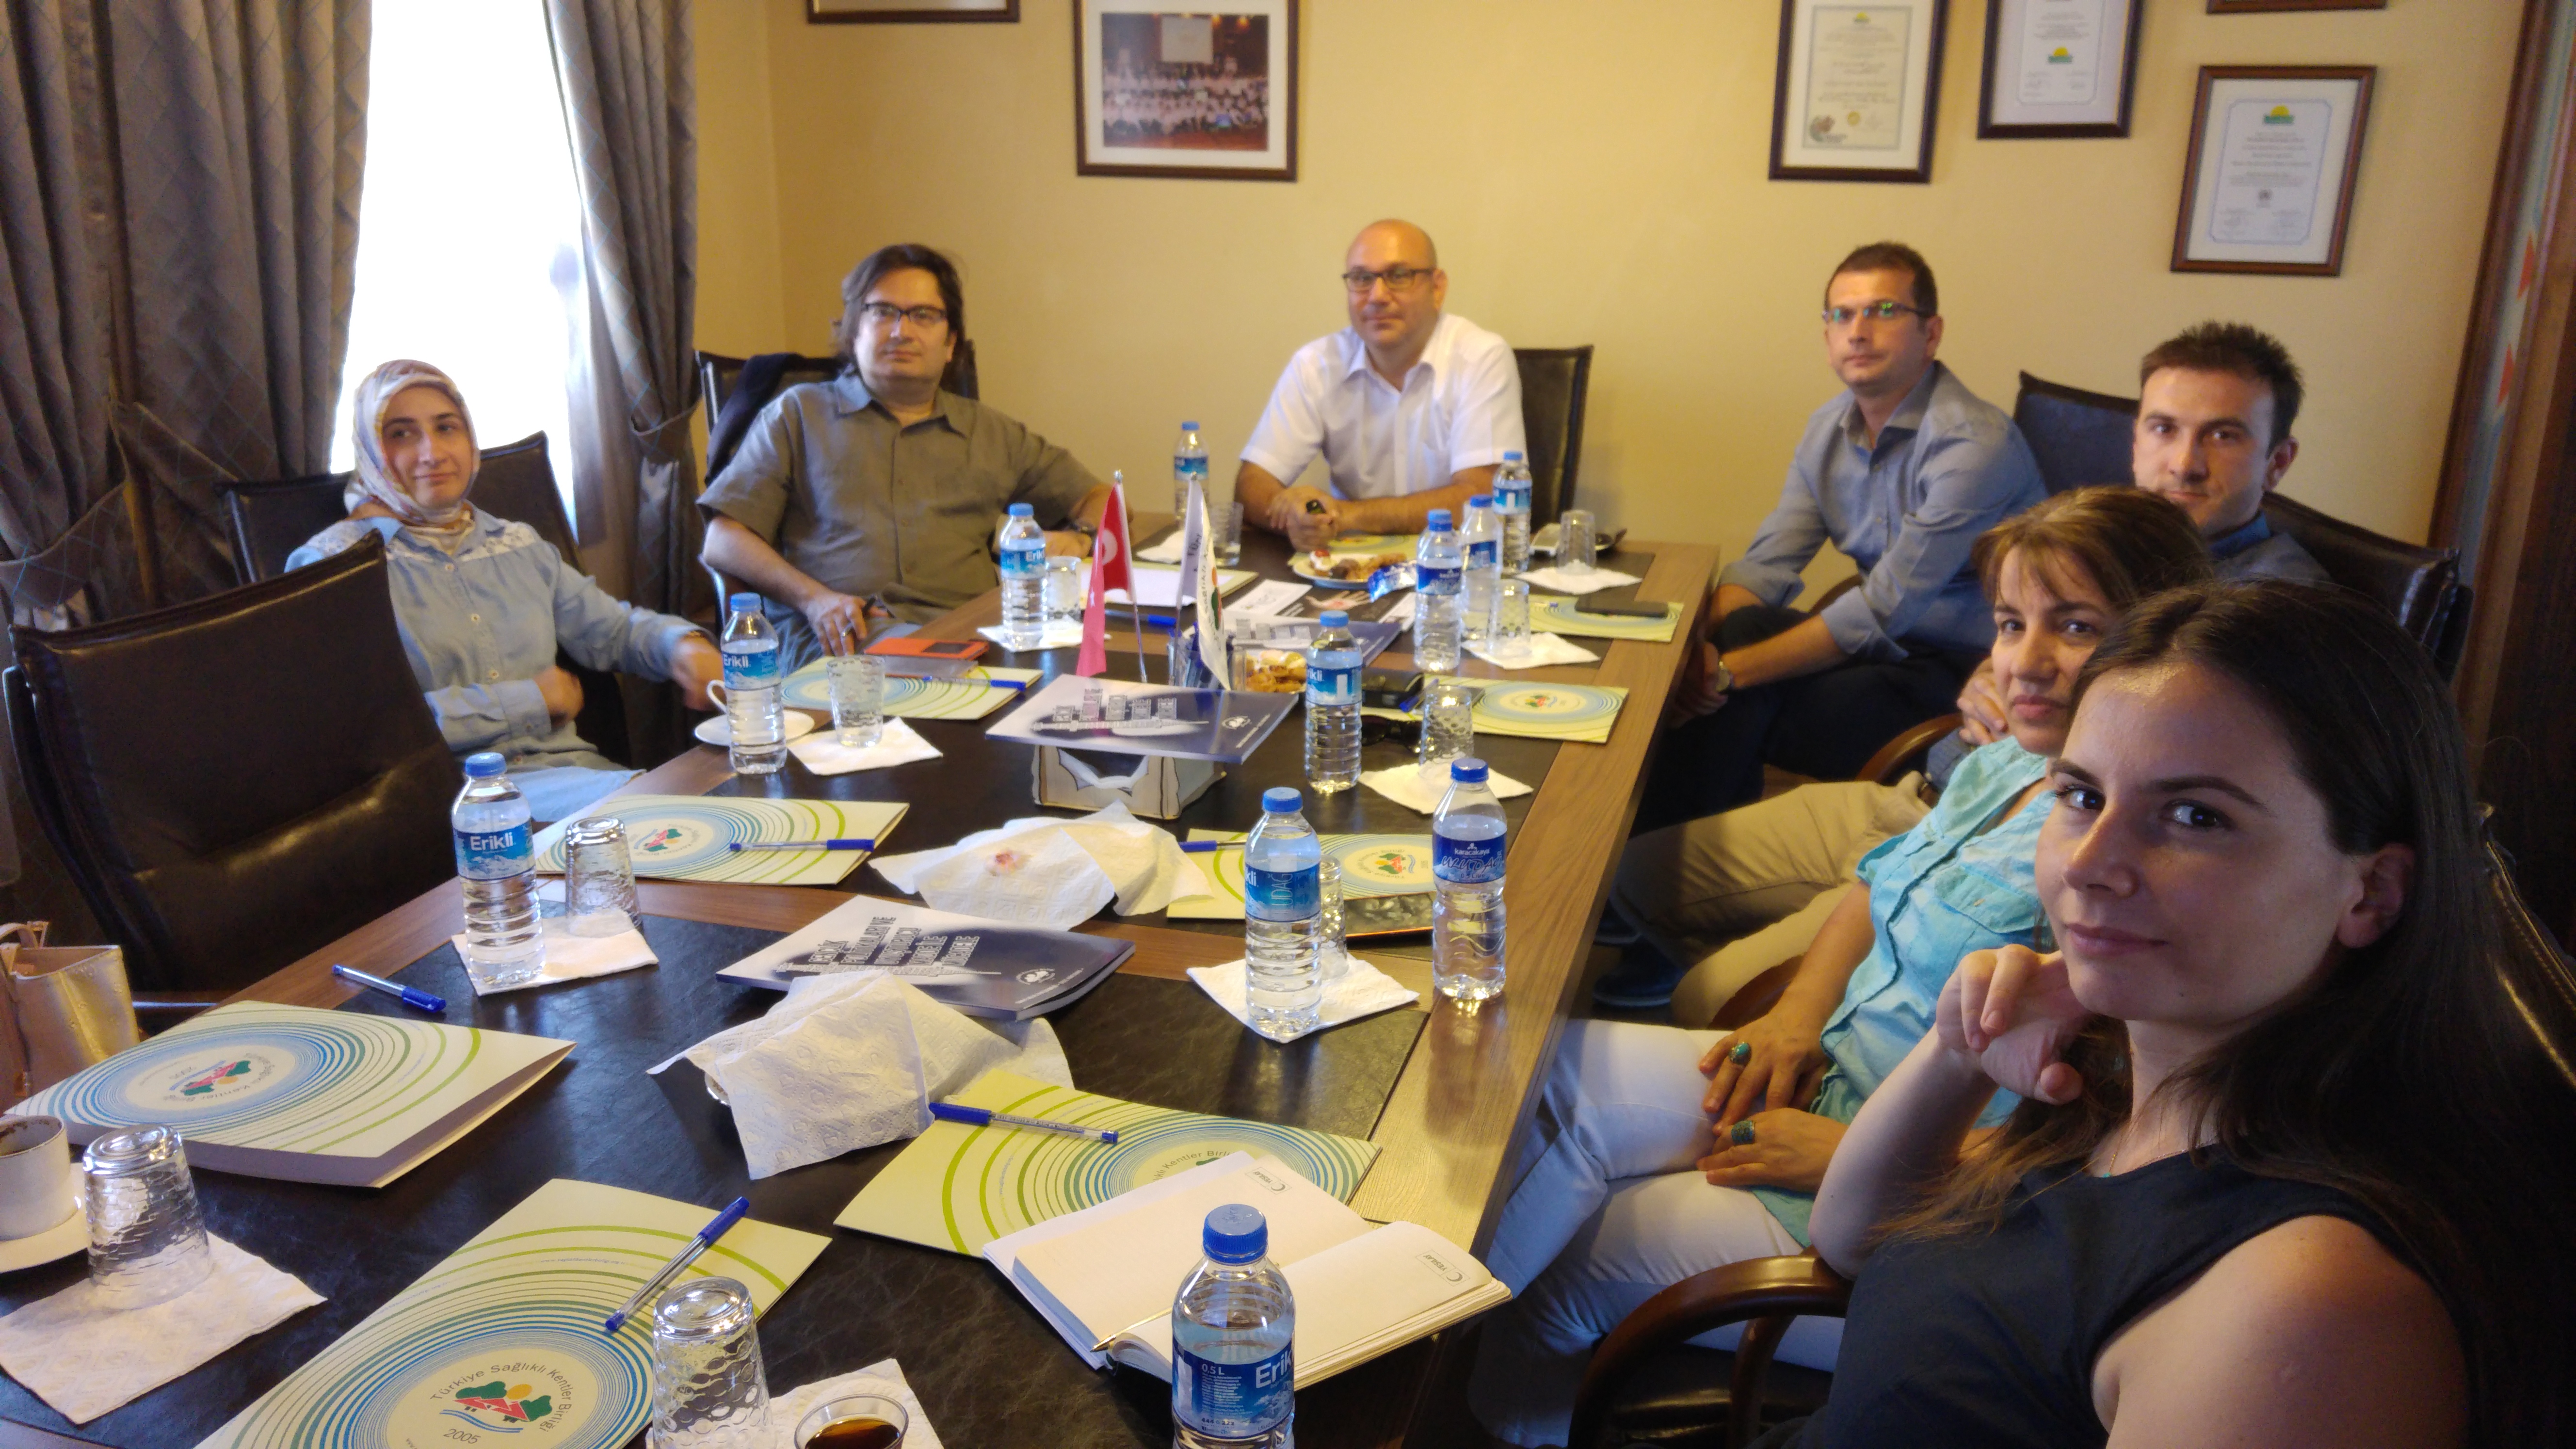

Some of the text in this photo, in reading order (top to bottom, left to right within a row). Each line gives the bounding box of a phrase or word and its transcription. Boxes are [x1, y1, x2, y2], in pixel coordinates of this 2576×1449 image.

[470, 832, 514, 851] Erikli
[1245, 867, 1257, 886] kli
[1162, 1152, 1202, 1169] Kentler
[1202, 1364, 1225, 1375] 0,5 L
[1256, 1350, 1292, 1388] Erik
[430, 1362, 572, 1432] Türkiye Sağlıklı Kentler Birliği
[443, 1429, 481, 1444] 2005
